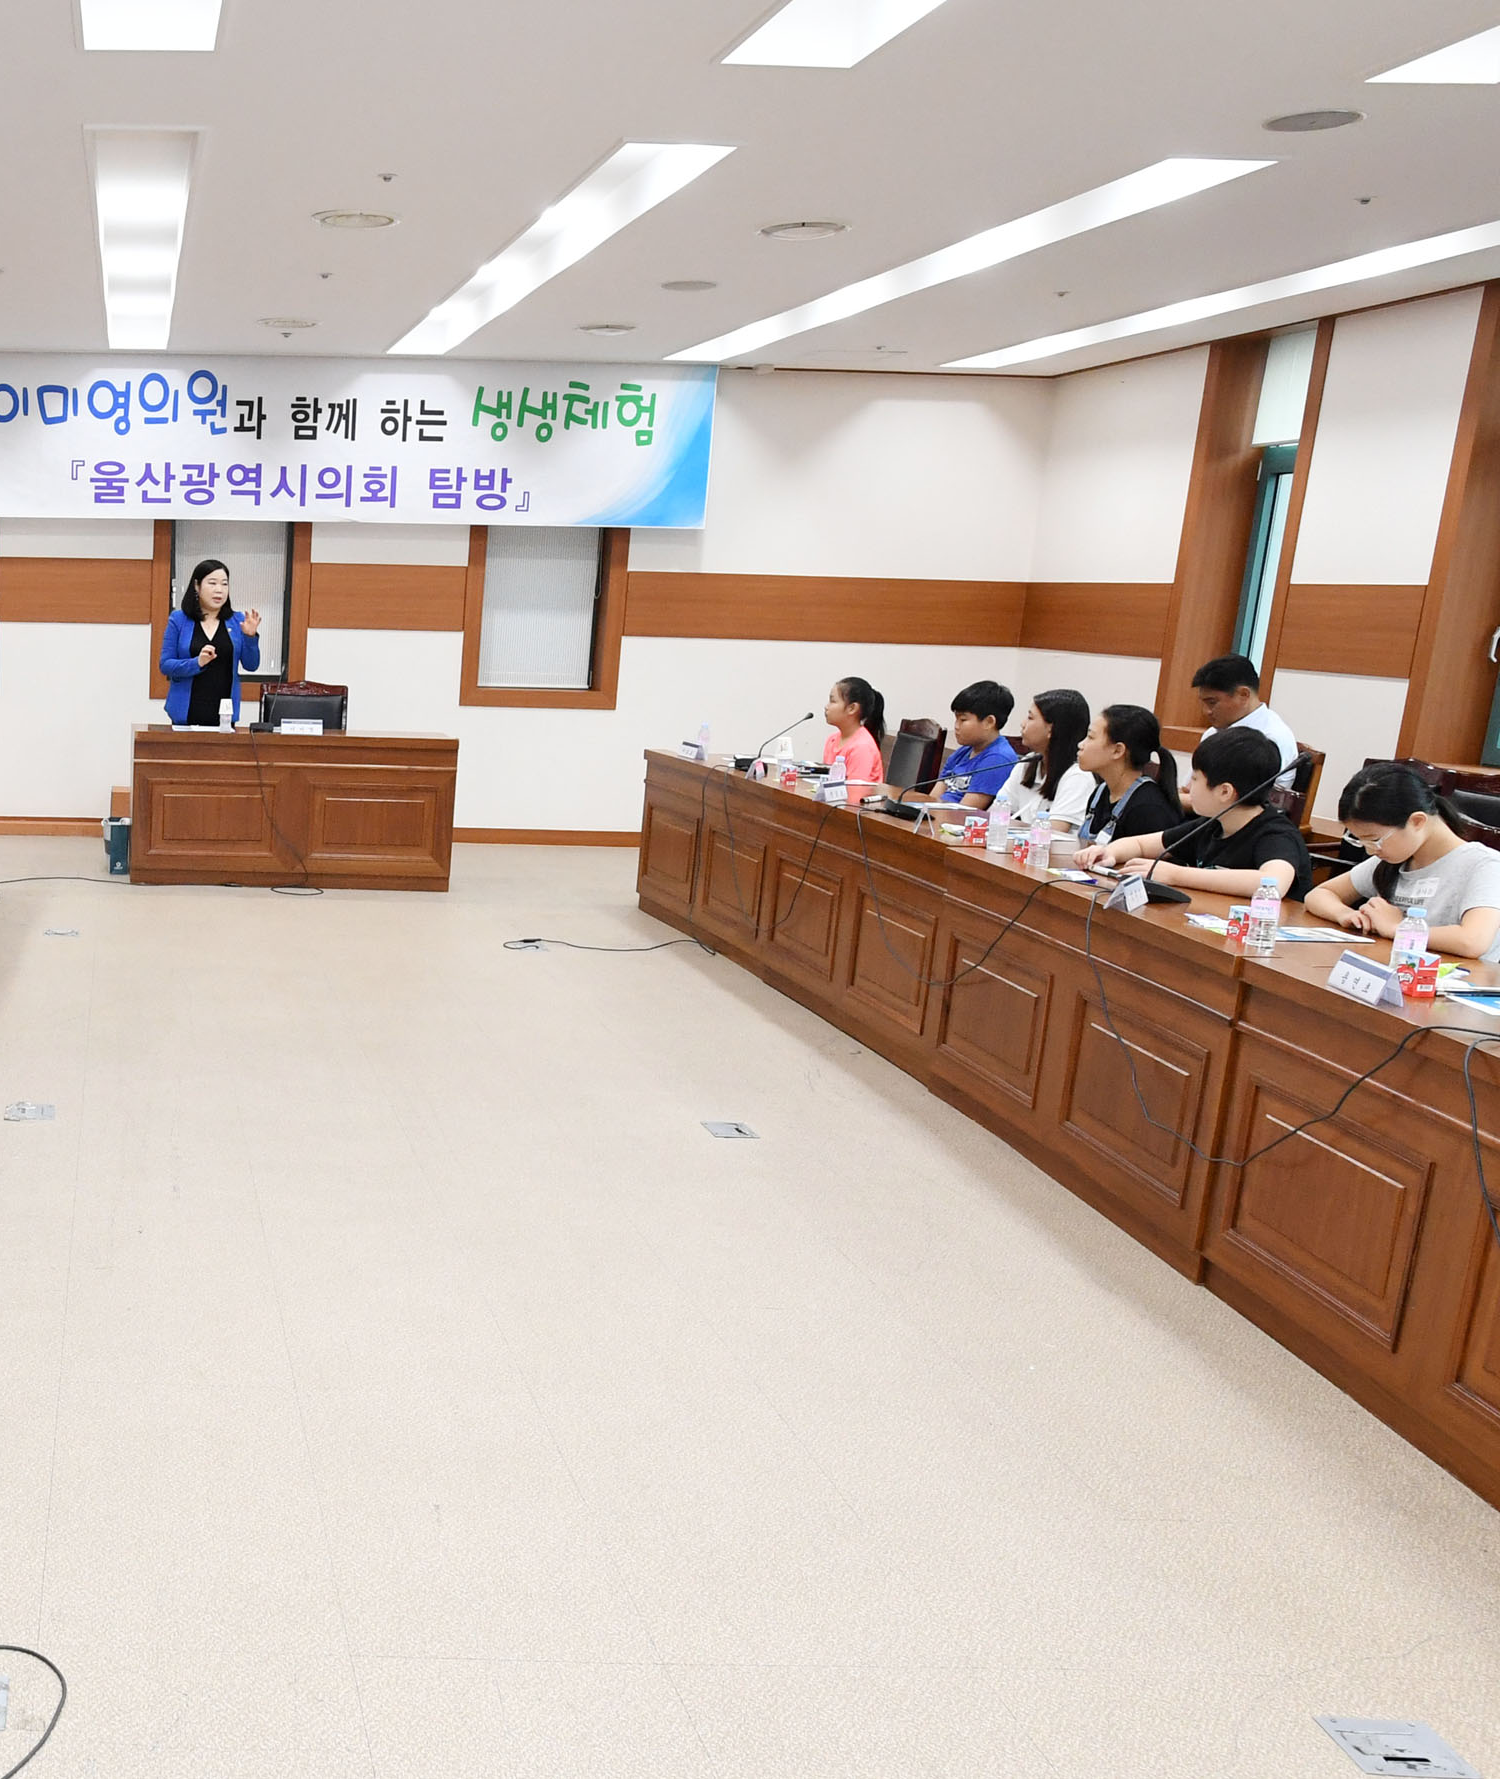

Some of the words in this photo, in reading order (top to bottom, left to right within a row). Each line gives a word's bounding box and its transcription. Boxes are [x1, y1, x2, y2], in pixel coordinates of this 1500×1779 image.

[290, 396, 358, 441] 함께
[380, 398, 448, 442] 하는
[471, 380, 657, 446] 생생체험
